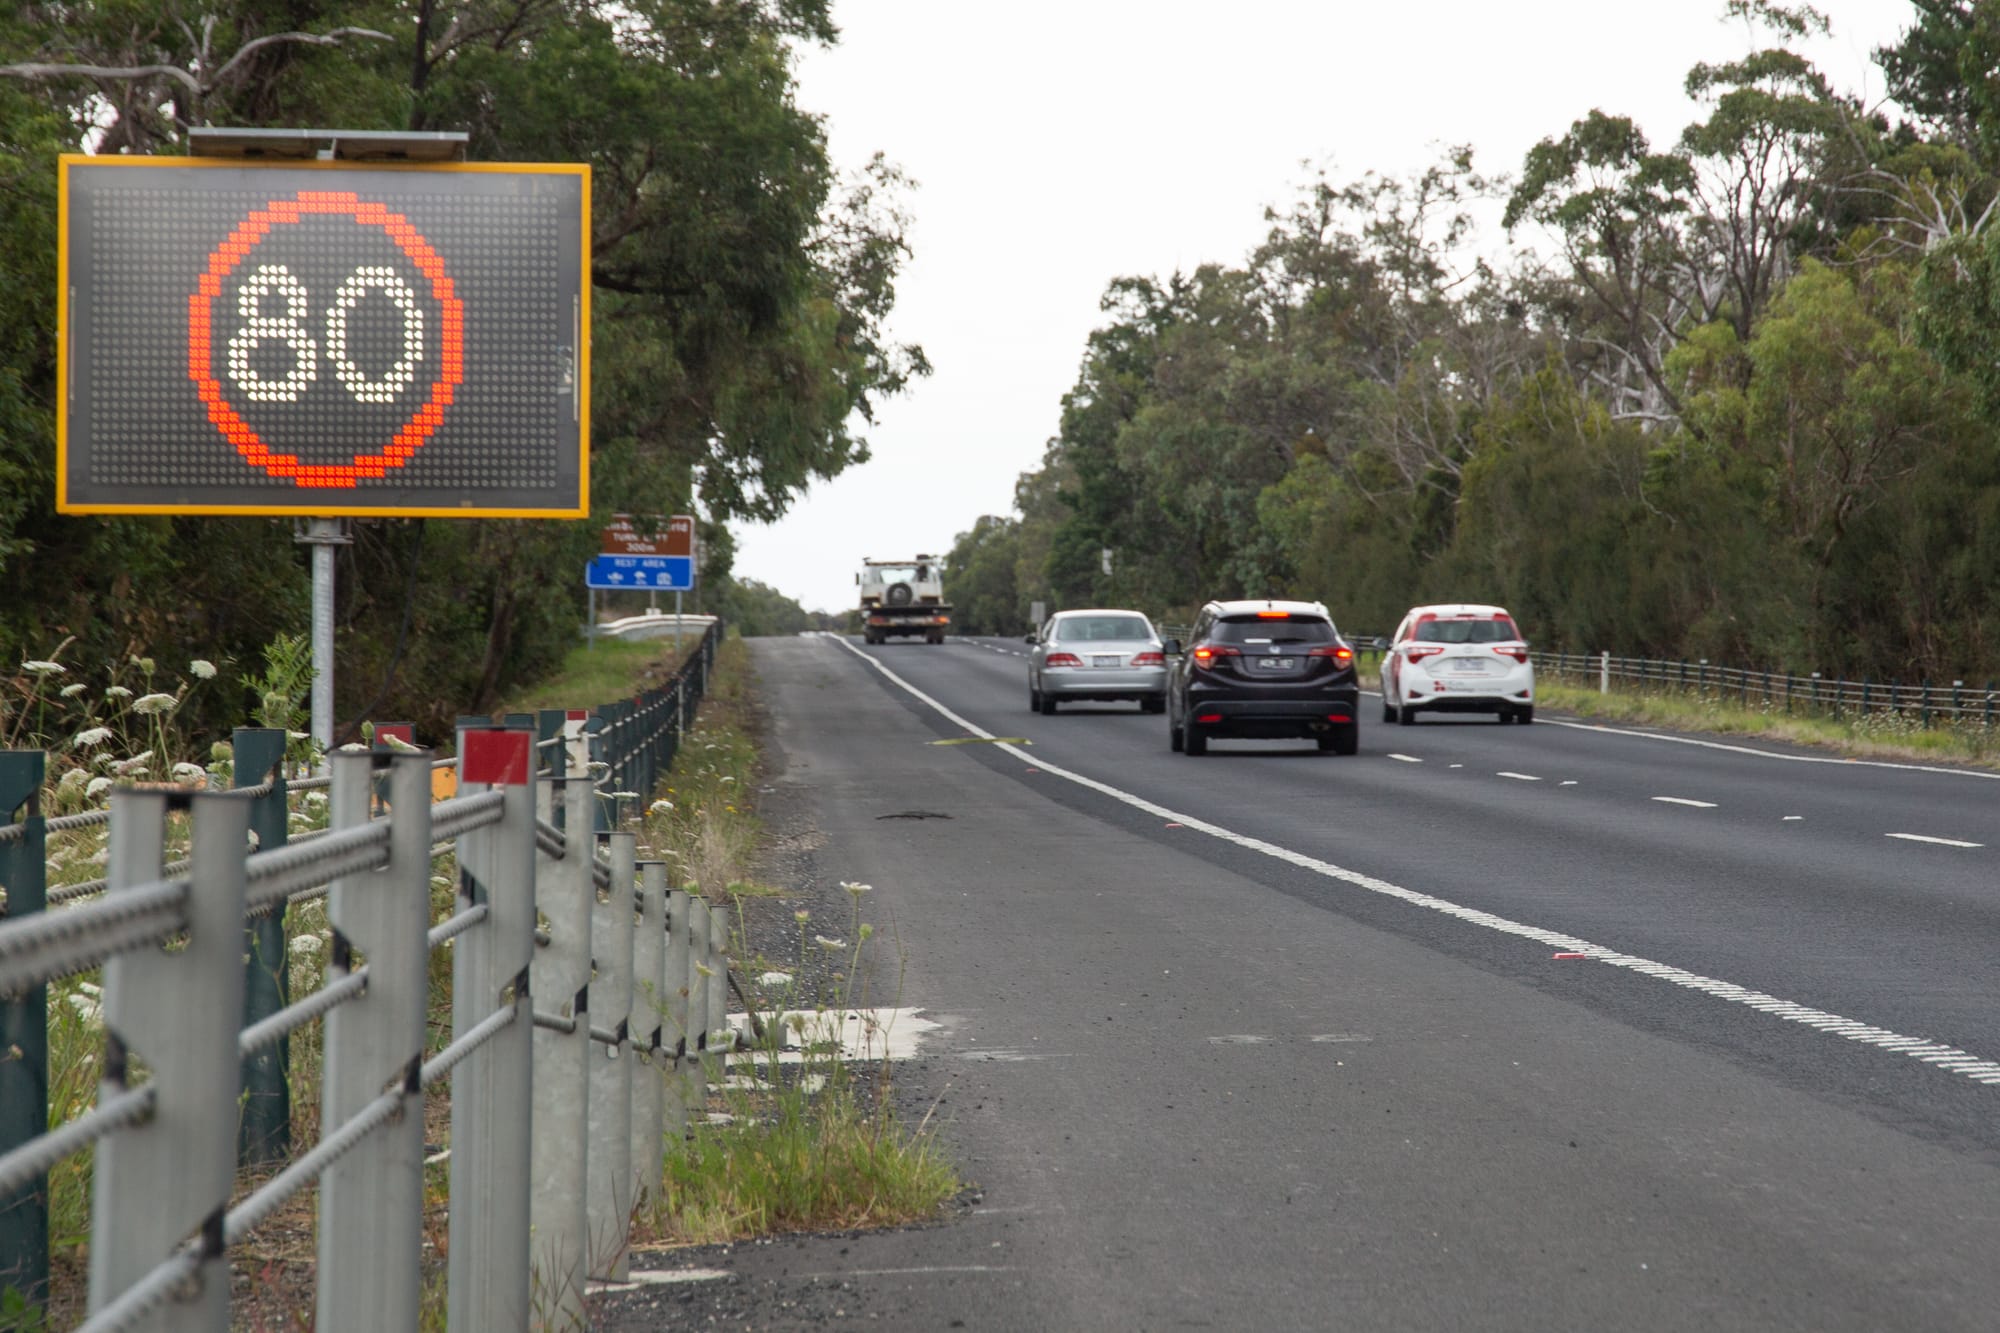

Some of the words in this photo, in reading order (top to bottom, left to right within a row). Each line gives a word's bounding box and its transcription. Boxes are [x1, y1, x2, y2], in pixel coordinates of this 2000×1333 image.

[228, 265, 424, 402] 80
[613, 533, 639, 542] TURN
[642, 534, 668, 542] LFT
[614, 559, 637, 567] REST
[642, 559, 666, 568] AREA
